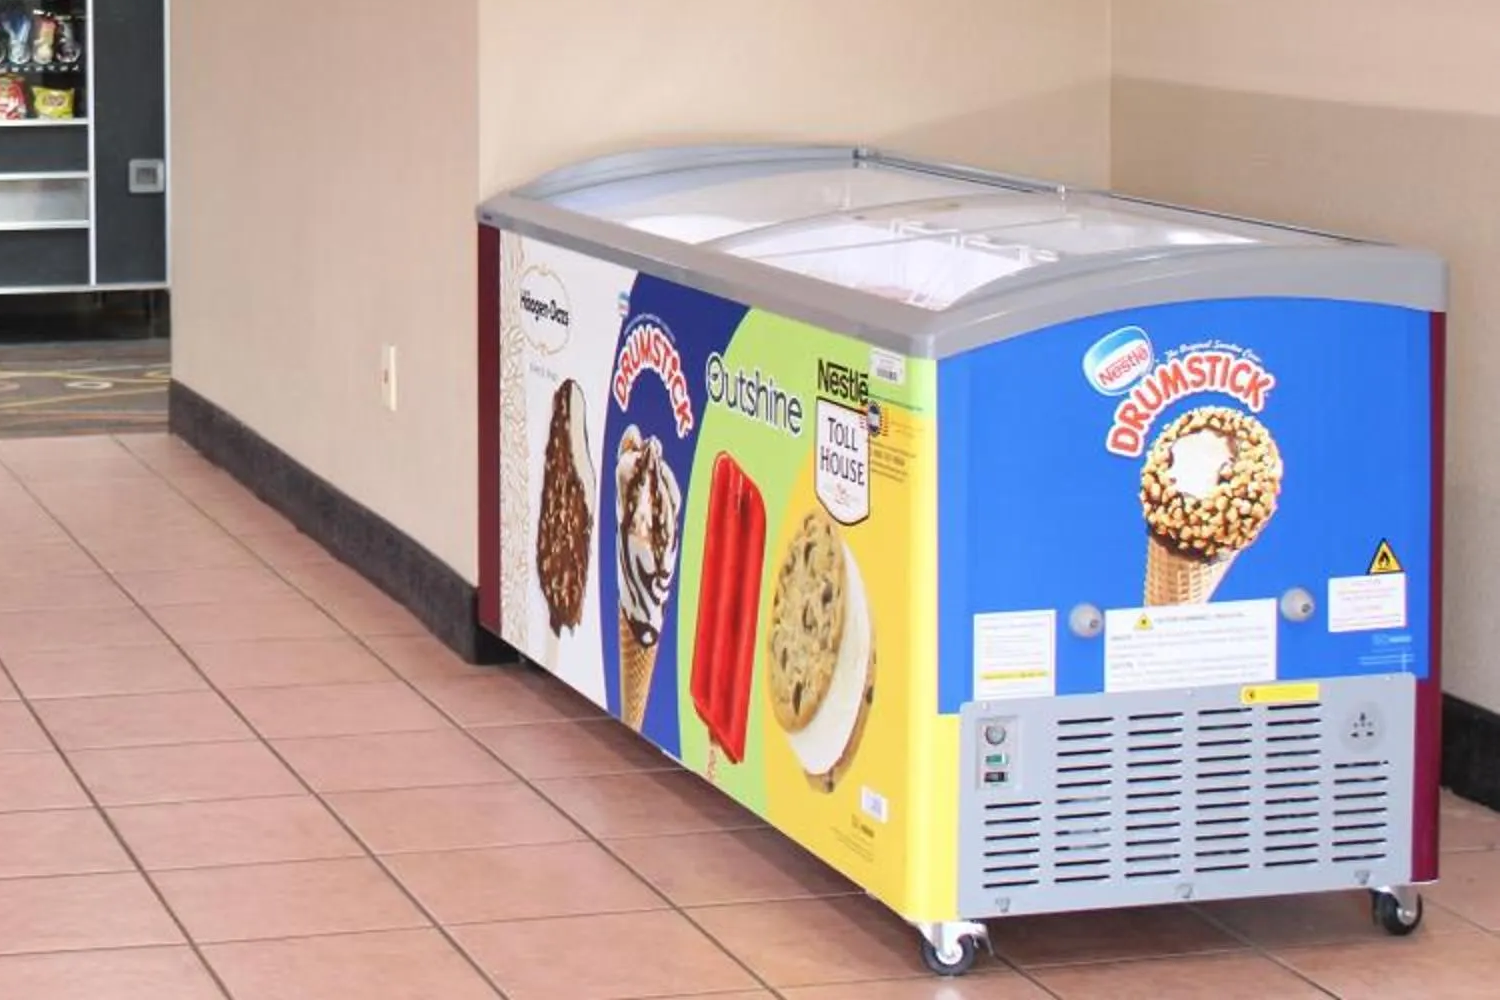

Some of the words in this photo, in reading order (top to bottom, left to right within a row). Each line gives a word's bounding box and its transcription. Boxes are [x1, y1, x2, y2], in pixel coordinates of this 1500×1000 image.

[614, 325, 692, 437] DRUMSTICK
[706, 353, 803, 435] Outshine
[1108, 353, 1273, 455] DRUMSTICK
[819, 445, 865, 486] HOUSE
[827, 416, 859, 451] TOLL
